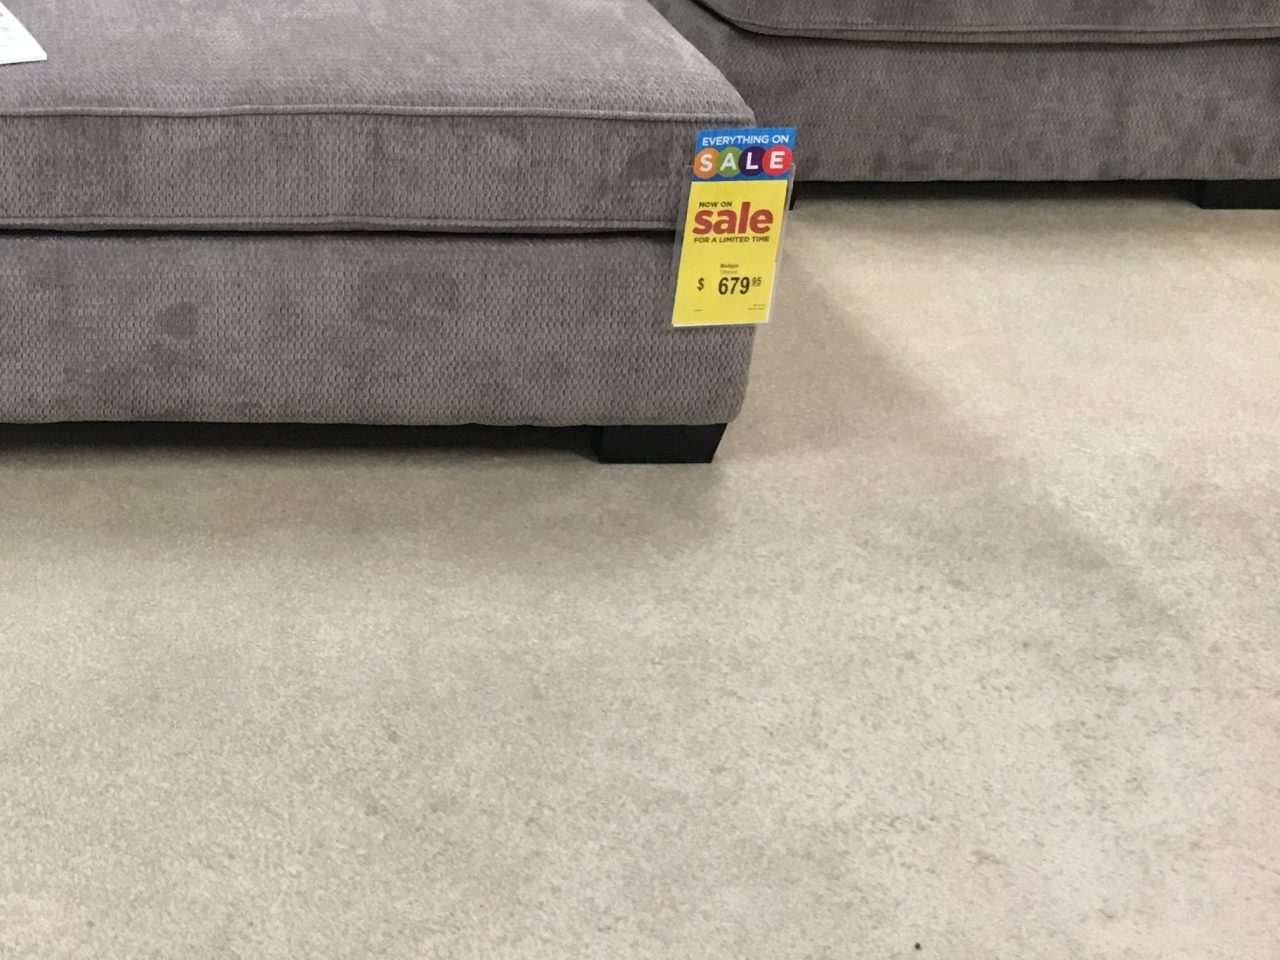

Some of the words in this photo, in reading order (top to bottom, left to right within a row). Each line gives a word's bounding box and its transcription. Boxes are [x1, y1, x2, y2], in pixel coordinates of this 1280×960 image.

[702, 135, 770, 146] EVERYTHING
[772, 134, 790, 144] ON
[699, 151, 786, 172] SALE
[720, 200, 733, 208] ON
[692, 202, 774, 235] sale
[752, 235, 770, 243] TIME
[697, 277, 705, 292] $
[718, 276, 750, 295] 679
